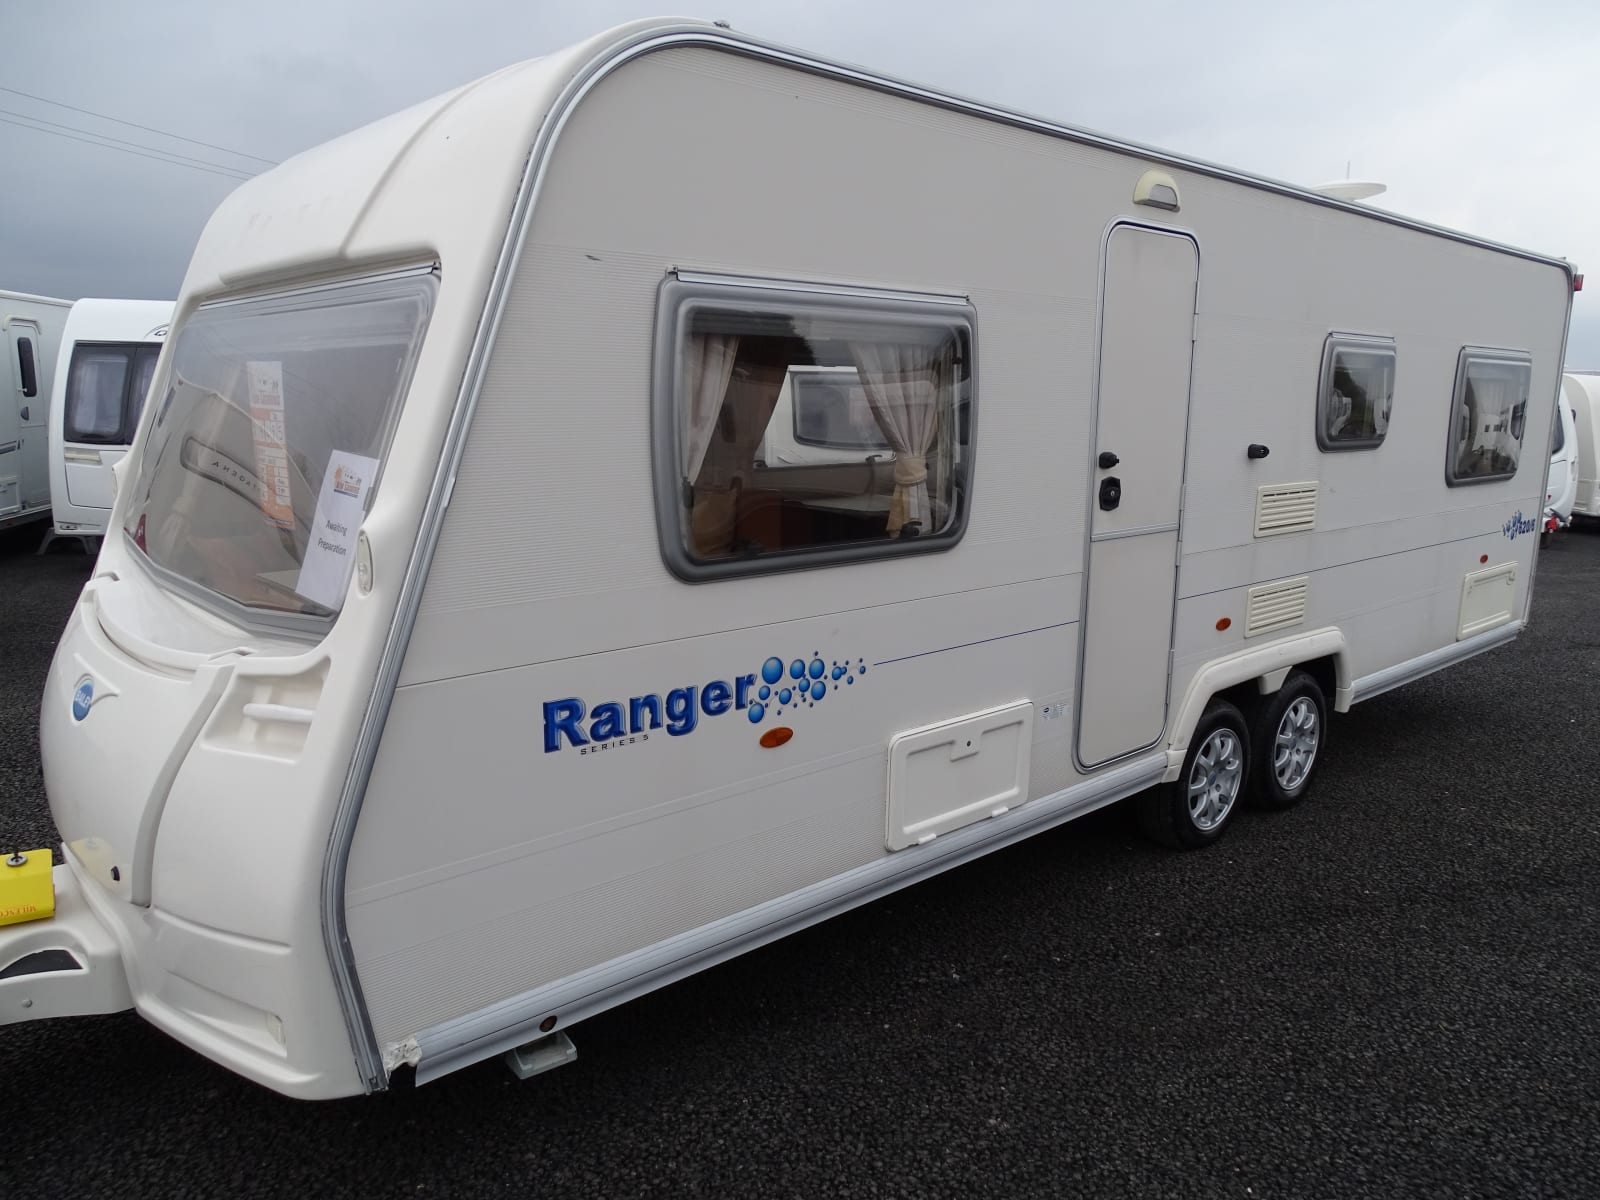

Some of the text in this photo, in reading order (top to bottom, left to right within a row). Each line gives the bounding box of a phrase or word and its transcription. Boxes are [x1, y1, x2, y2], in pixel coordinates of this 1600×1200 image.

[326, 519, 348, 537] Awaiting
[317, 537, 347, 556] Preparation
[542, 671, 759, 755] Ranger
[580, 737, 636, 755] SERIES
